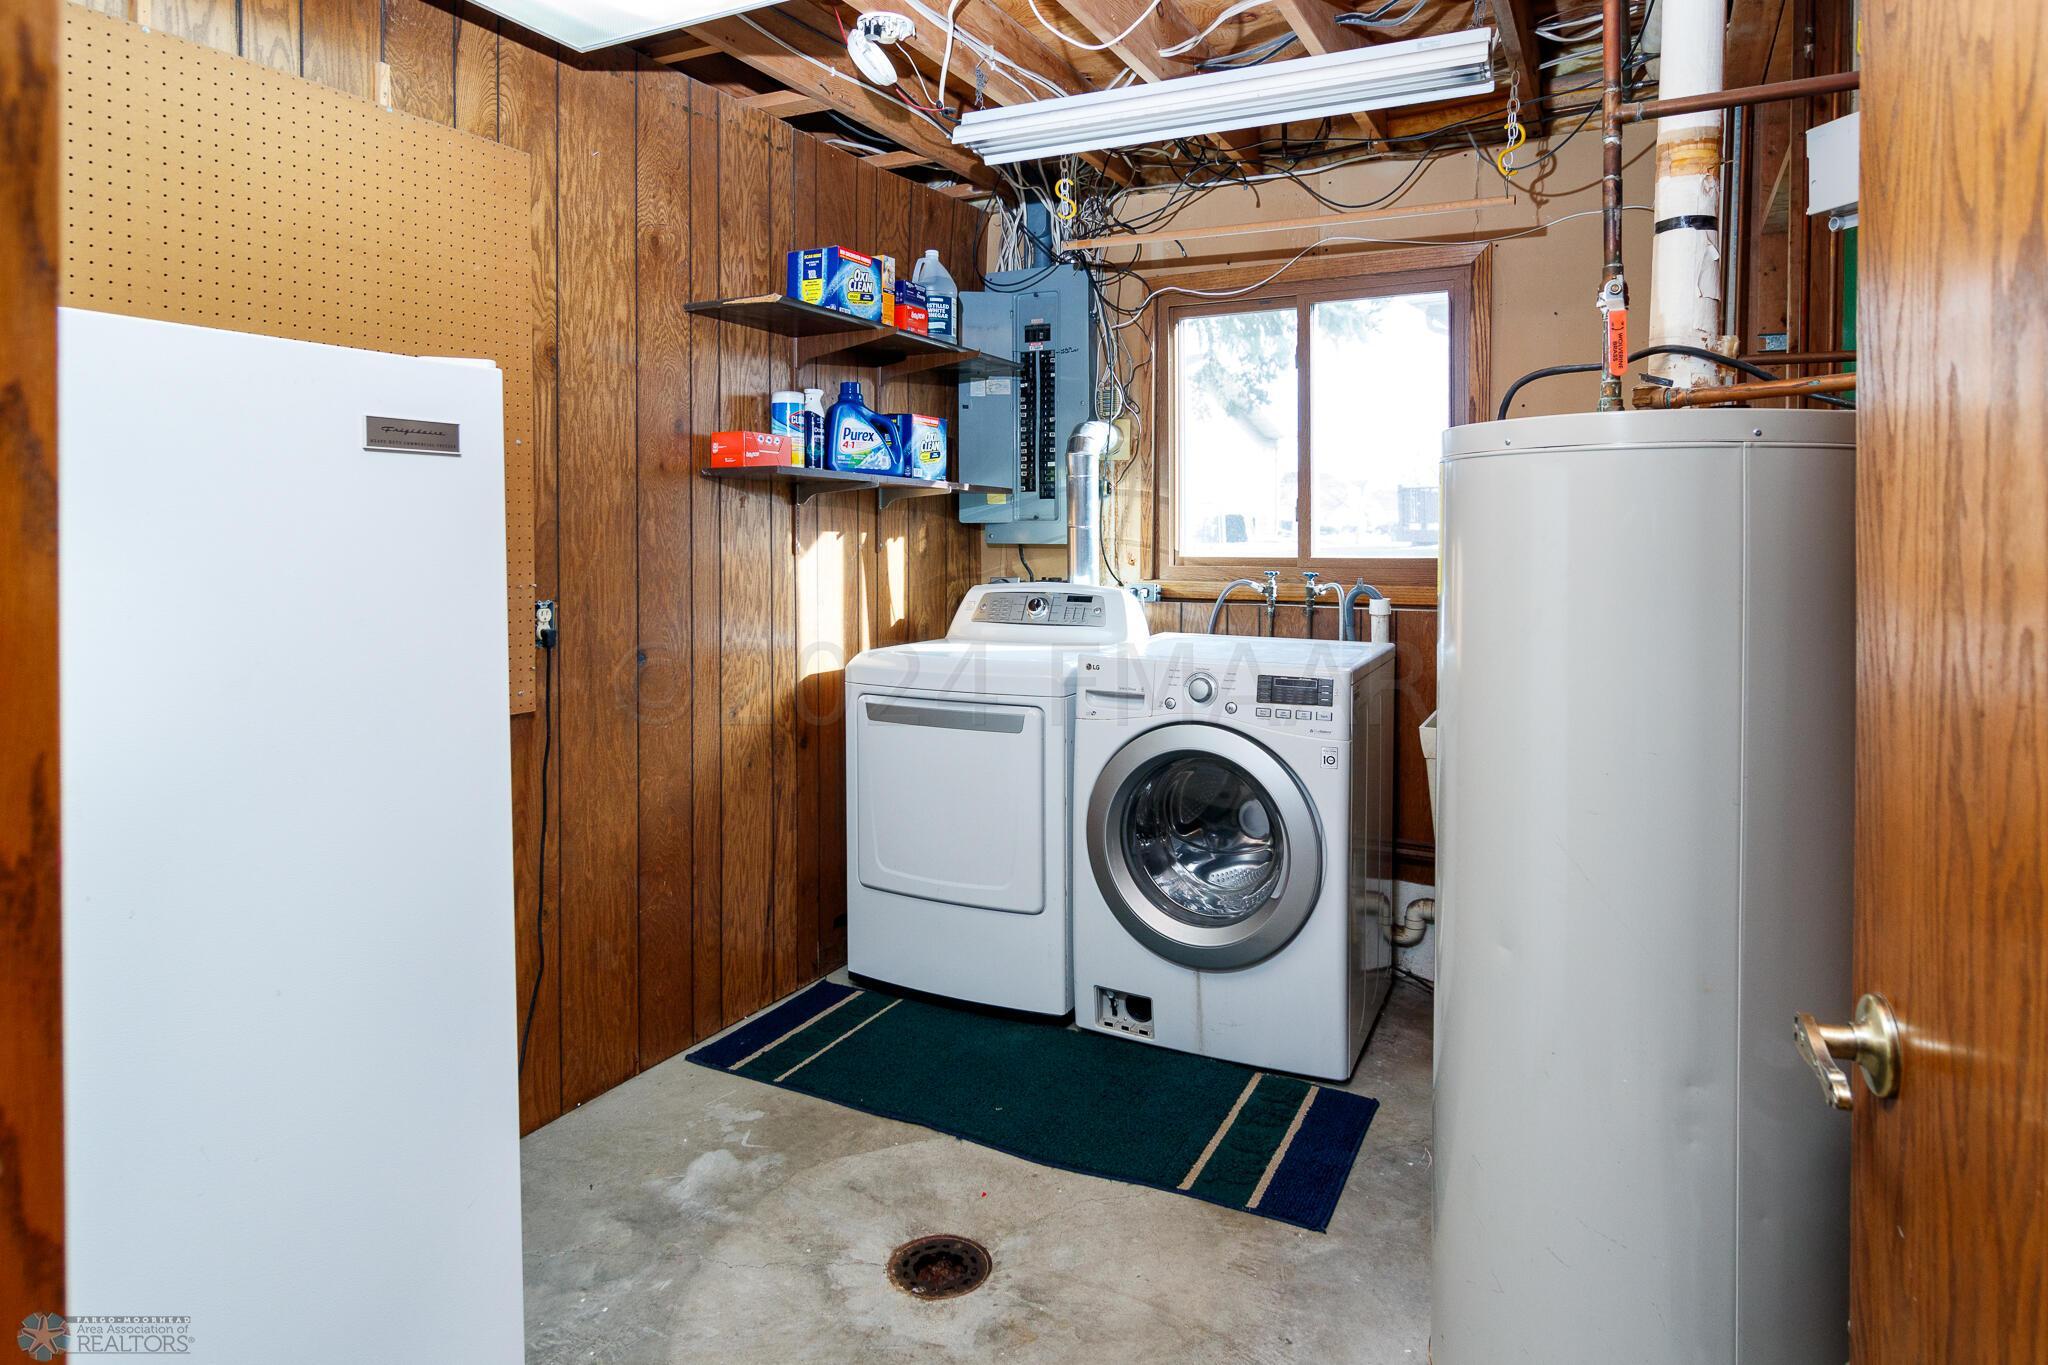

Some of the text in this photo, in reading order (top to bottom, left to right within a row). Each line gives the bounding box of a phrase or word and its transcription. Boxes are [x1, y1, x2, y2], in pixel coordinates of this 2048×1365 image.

[854, 268, 869, 281] OXI
[848, 278, 873, 292] CLEAN
[381, 426, 446, 436] Frigidaire
[843, 427, 874, 442] Purex
[921, 440, 940, 451] CLEAN
